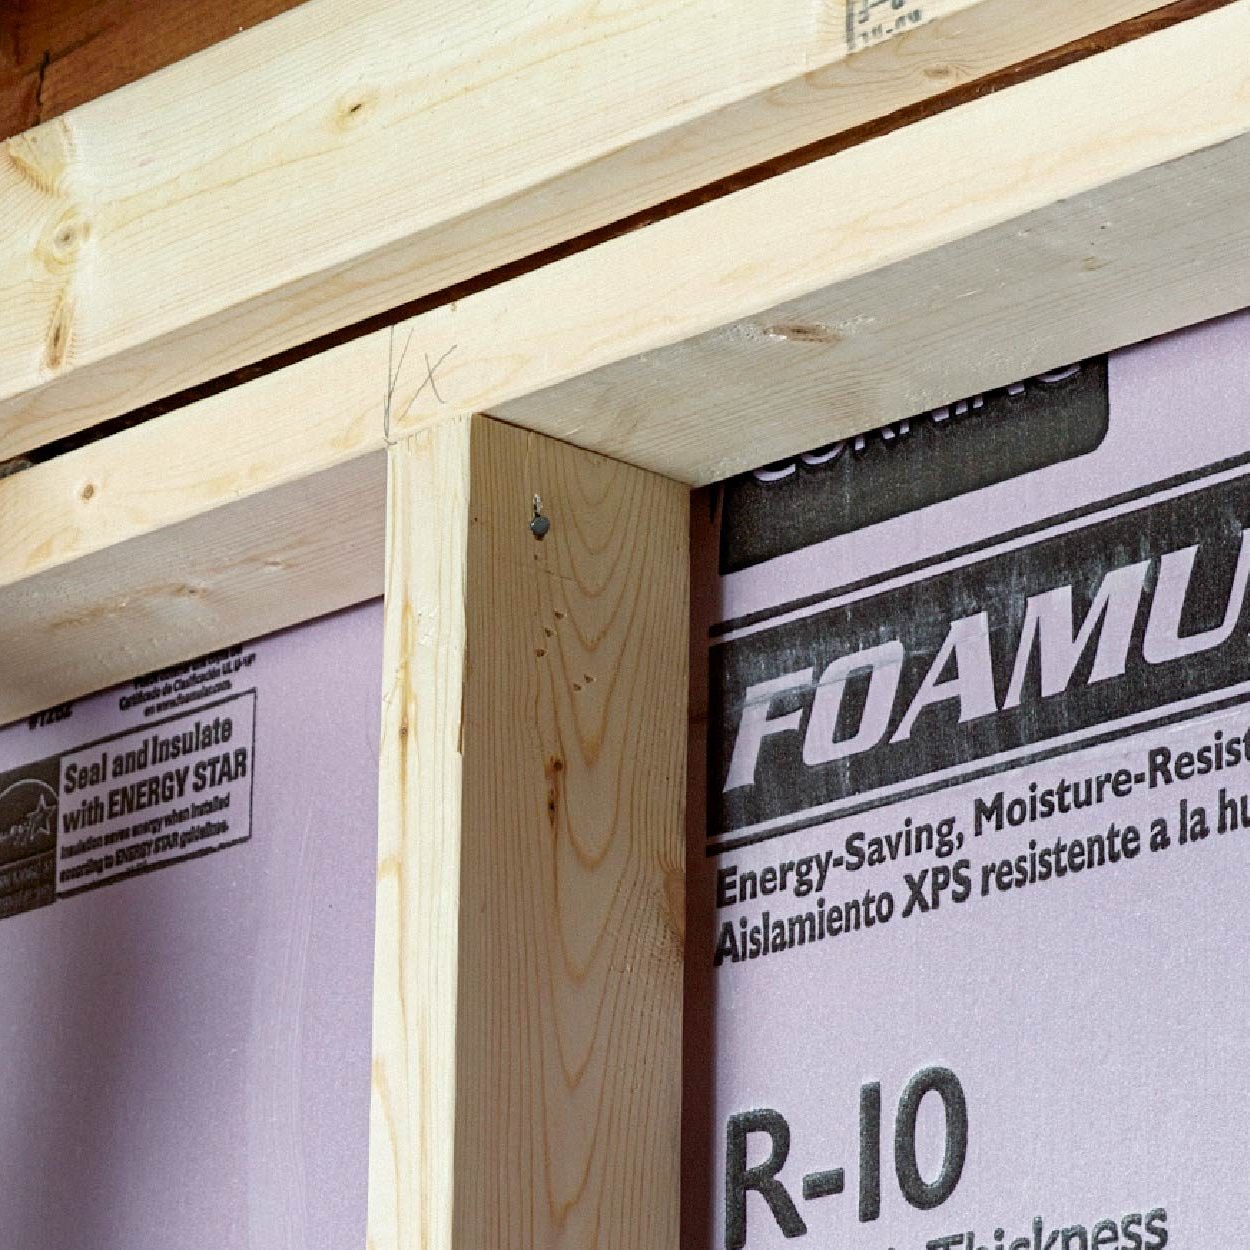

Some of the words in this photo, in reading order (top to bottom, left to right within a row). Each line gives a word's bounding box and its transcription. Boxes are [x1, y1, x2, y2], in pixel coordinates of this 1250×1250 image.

[63, 752, 107, 794] Seal
[112, 737, 148, 779] and
[152, 717, 232, 765] Insulate
[63, 796, 104, 833] with
[107, 765, 190, 820] ENERGY
[192, 747, 247, 792] STAR
[714, 889, 894, 966] Aislamiento
[902, 859, 971, 918] XPS
[981, 822, 1141, 898] resistente
[1150, 817, 1171, 852] a
[1179, 799, 1210, 846] la
[715, 817, 964, 908] Energy-Saving,
